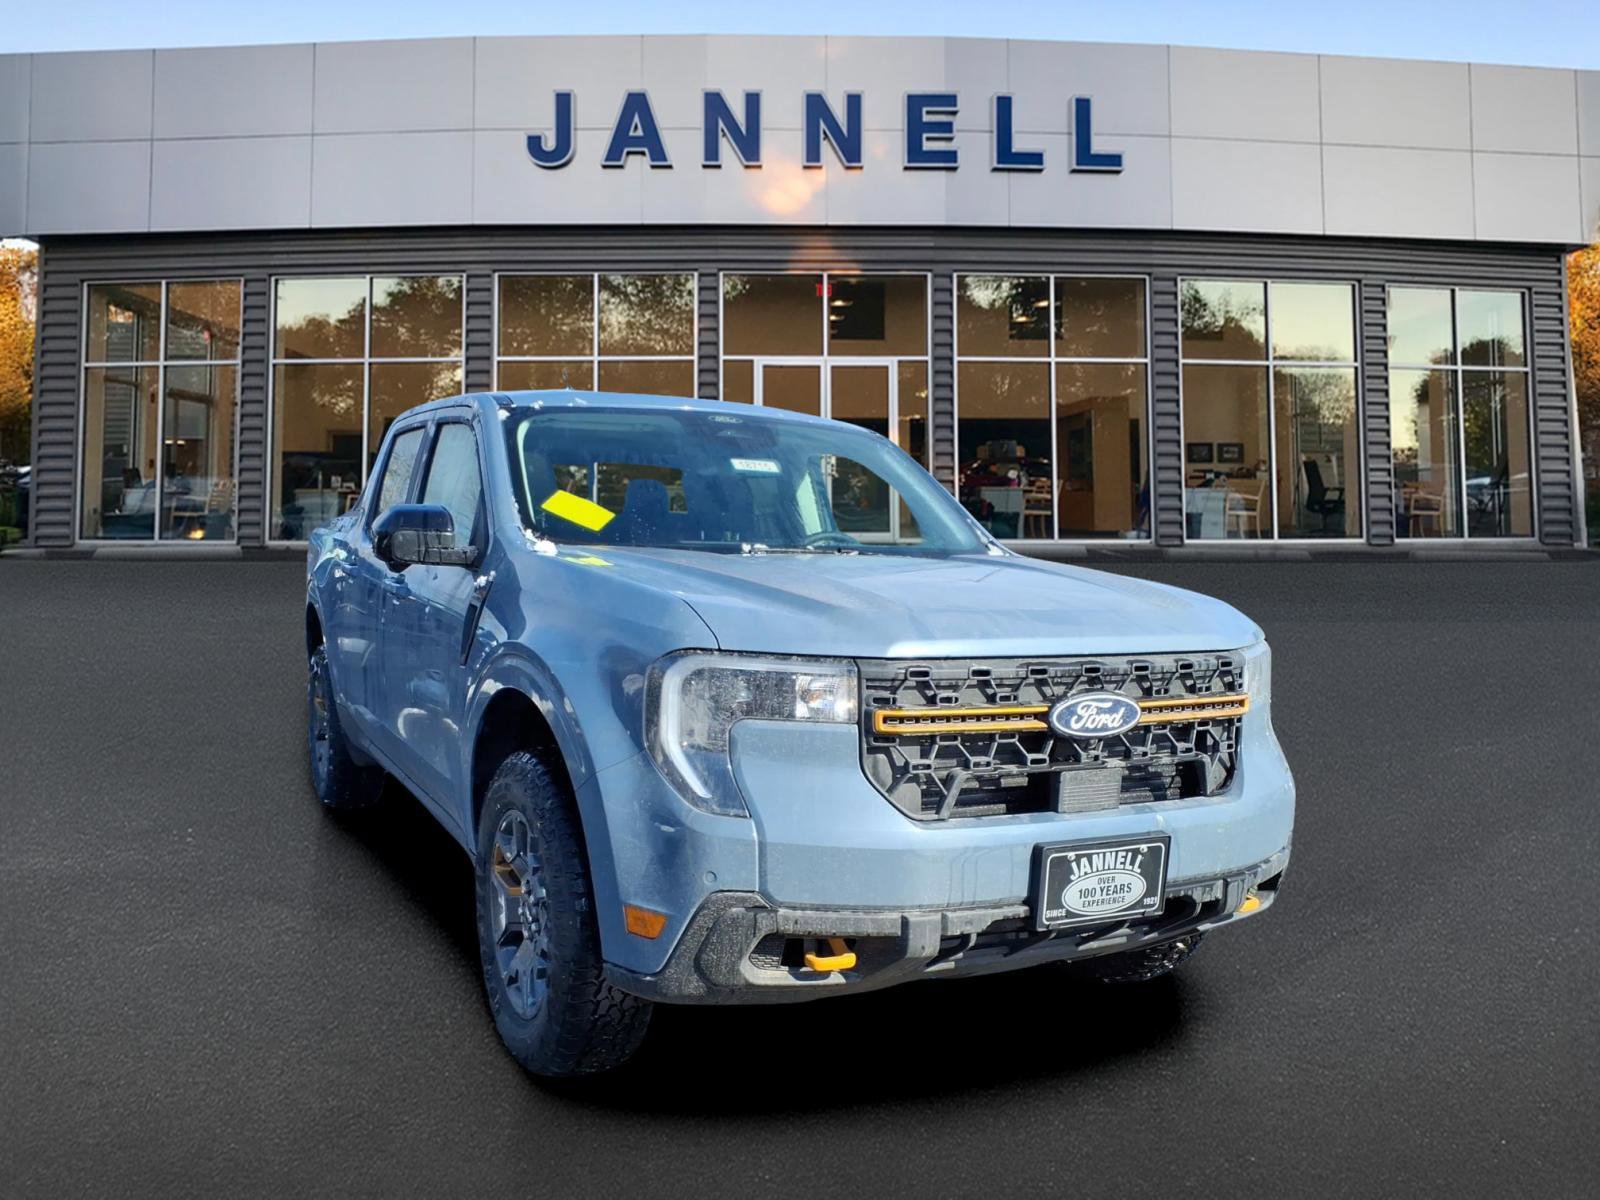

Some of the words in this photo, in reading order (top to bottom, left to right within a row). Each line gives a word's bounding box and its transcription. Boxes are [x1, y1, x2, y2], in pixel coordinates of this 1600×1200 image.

[526, 90, 1124, 173] JANNELL
[1070, 701, 1126, 730] Ford
[1070, 851, 1144, 880] JANNELL
[1078, 887, 1097, 899] 100
[1099, 882, 1132, 897] YEARS
[1097, 876, 1116, 885] OVER
[1046, 909, 1067, 918] SINCE
[1143, 896, 1158, 905] 1921
[1082, 896, 1126, 908] EXPERIENCE
